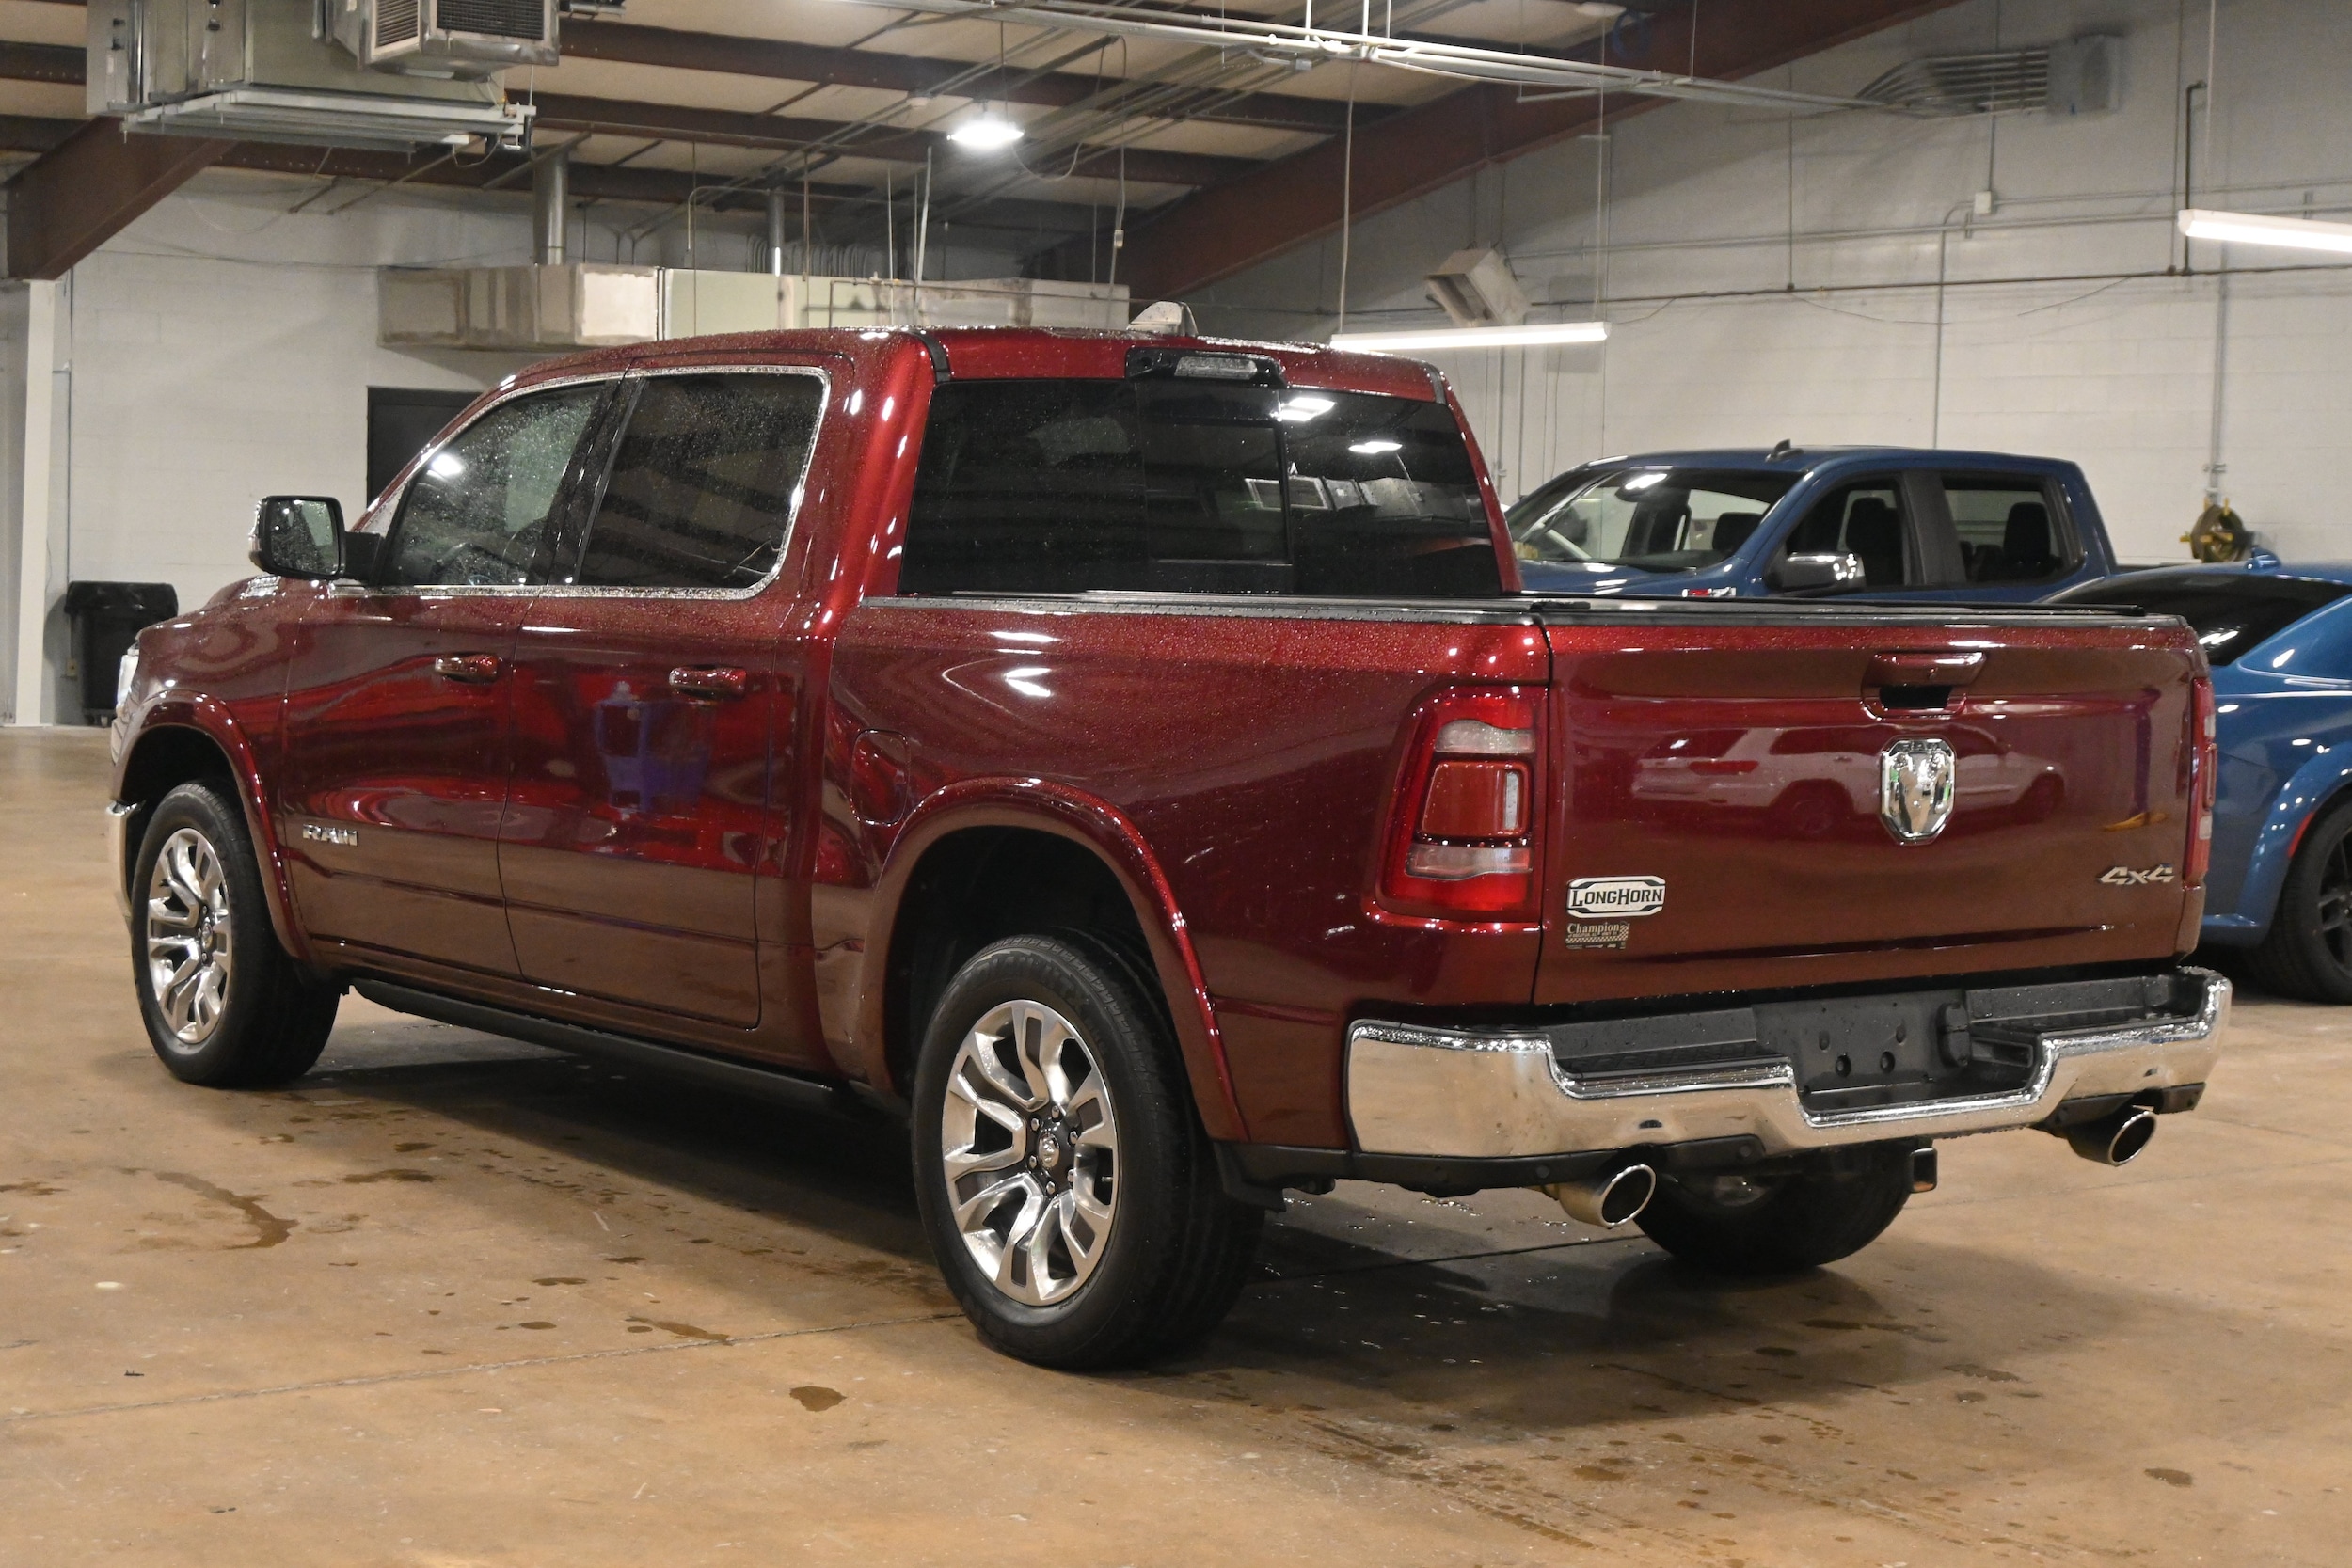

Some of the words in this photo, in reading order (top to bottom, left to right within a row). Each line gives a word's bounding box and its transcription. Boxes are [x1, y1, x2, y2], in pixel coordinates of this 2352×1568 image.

[302, 823, 358, 847] RAM
[1571, 888, 1663, 907] LONGHORN
[1566, 922, 1620, 937] Champion
